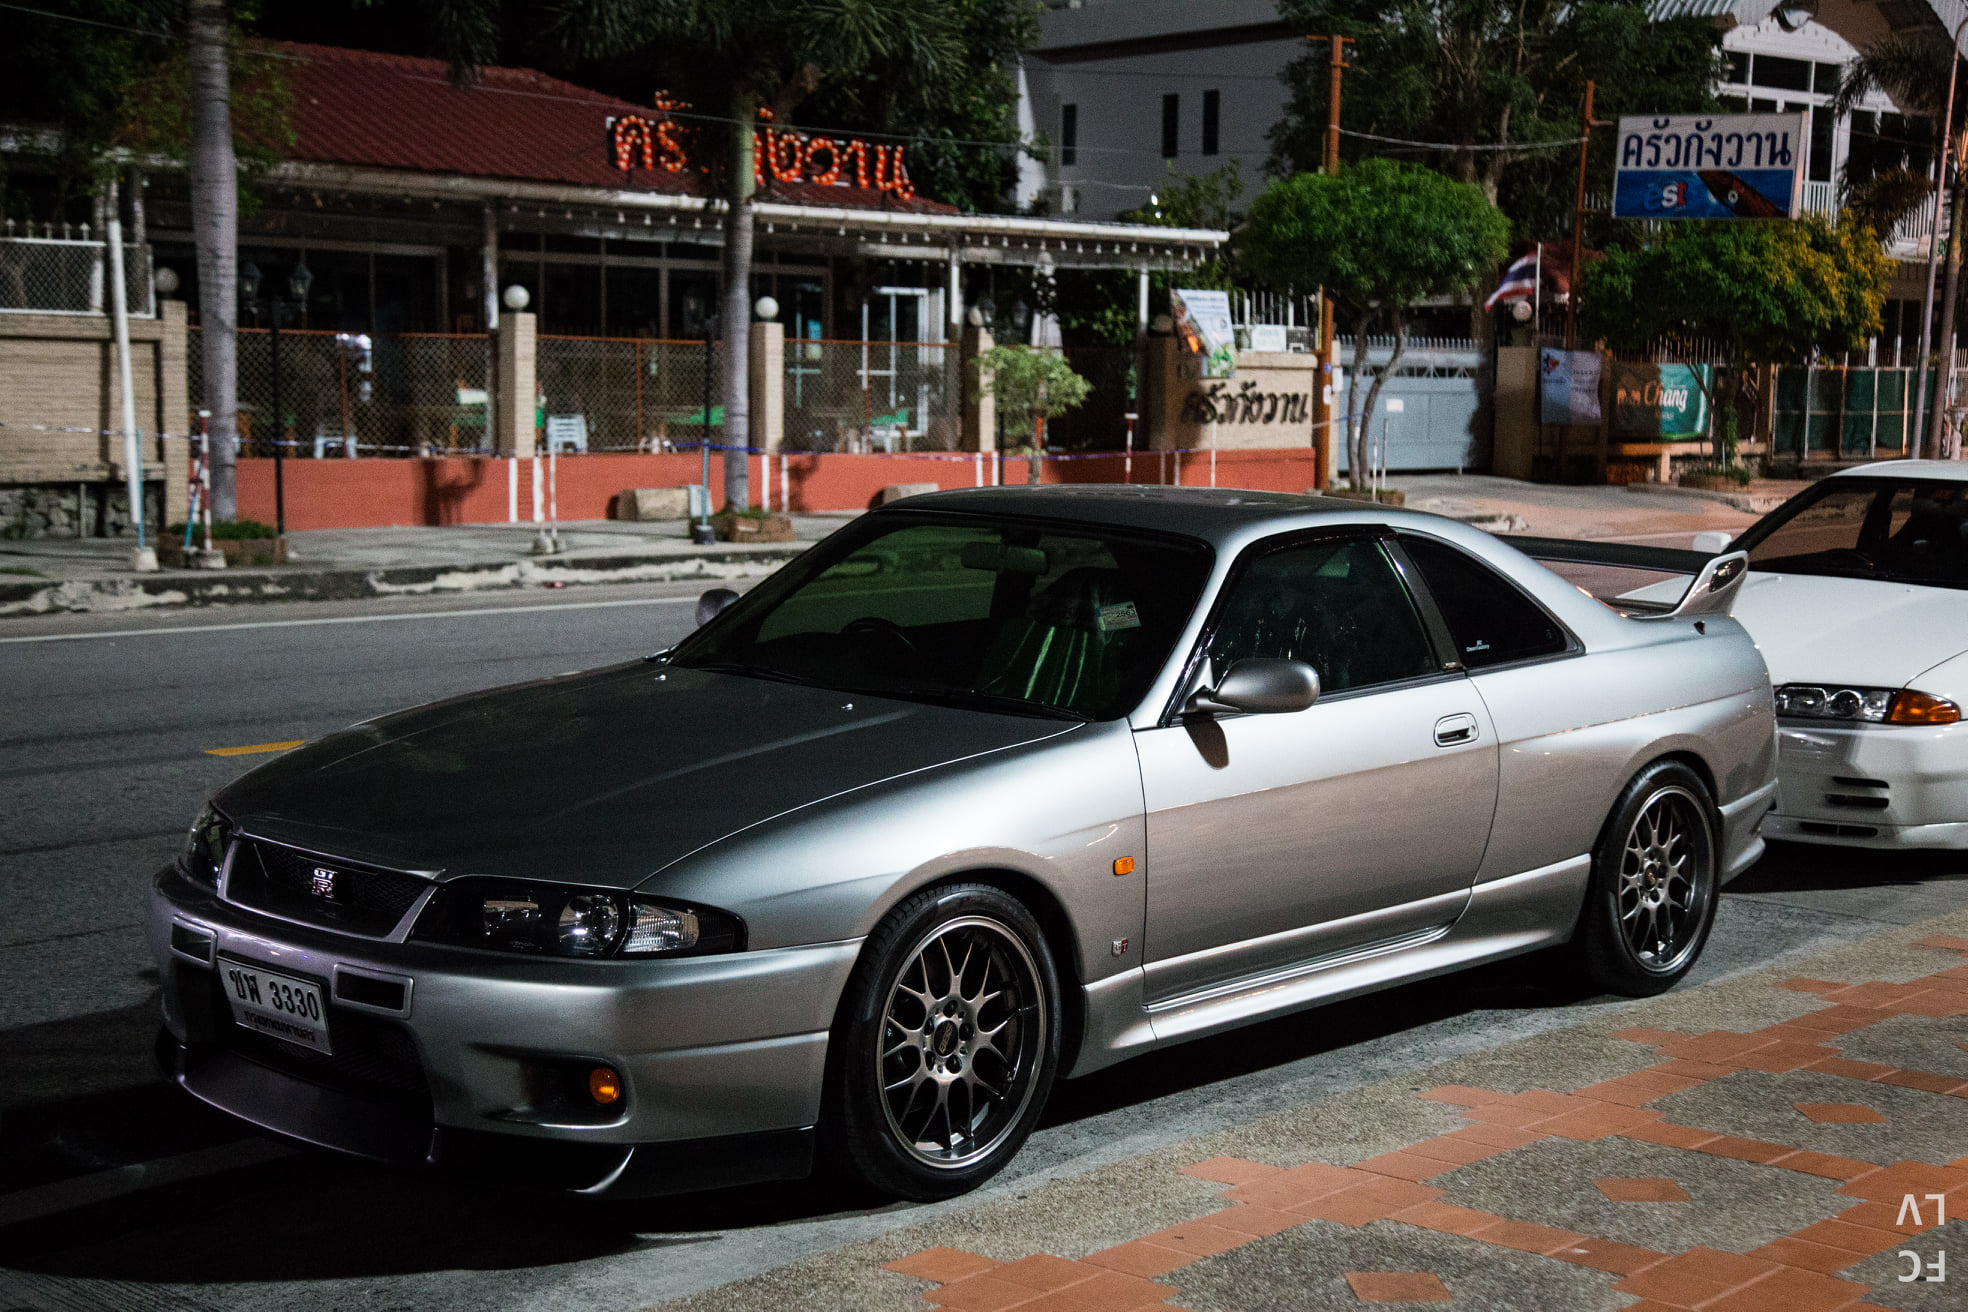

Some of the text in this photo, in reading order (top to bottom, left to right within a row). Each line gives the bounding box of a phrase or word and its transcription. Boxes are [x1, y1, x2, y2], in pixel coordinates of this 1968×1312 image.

[1622, 118, 1792, 167] ครัวกังวาน
[1644, 380, 1688, 413] Chang
[269, 980, 319, 1021] 3330
